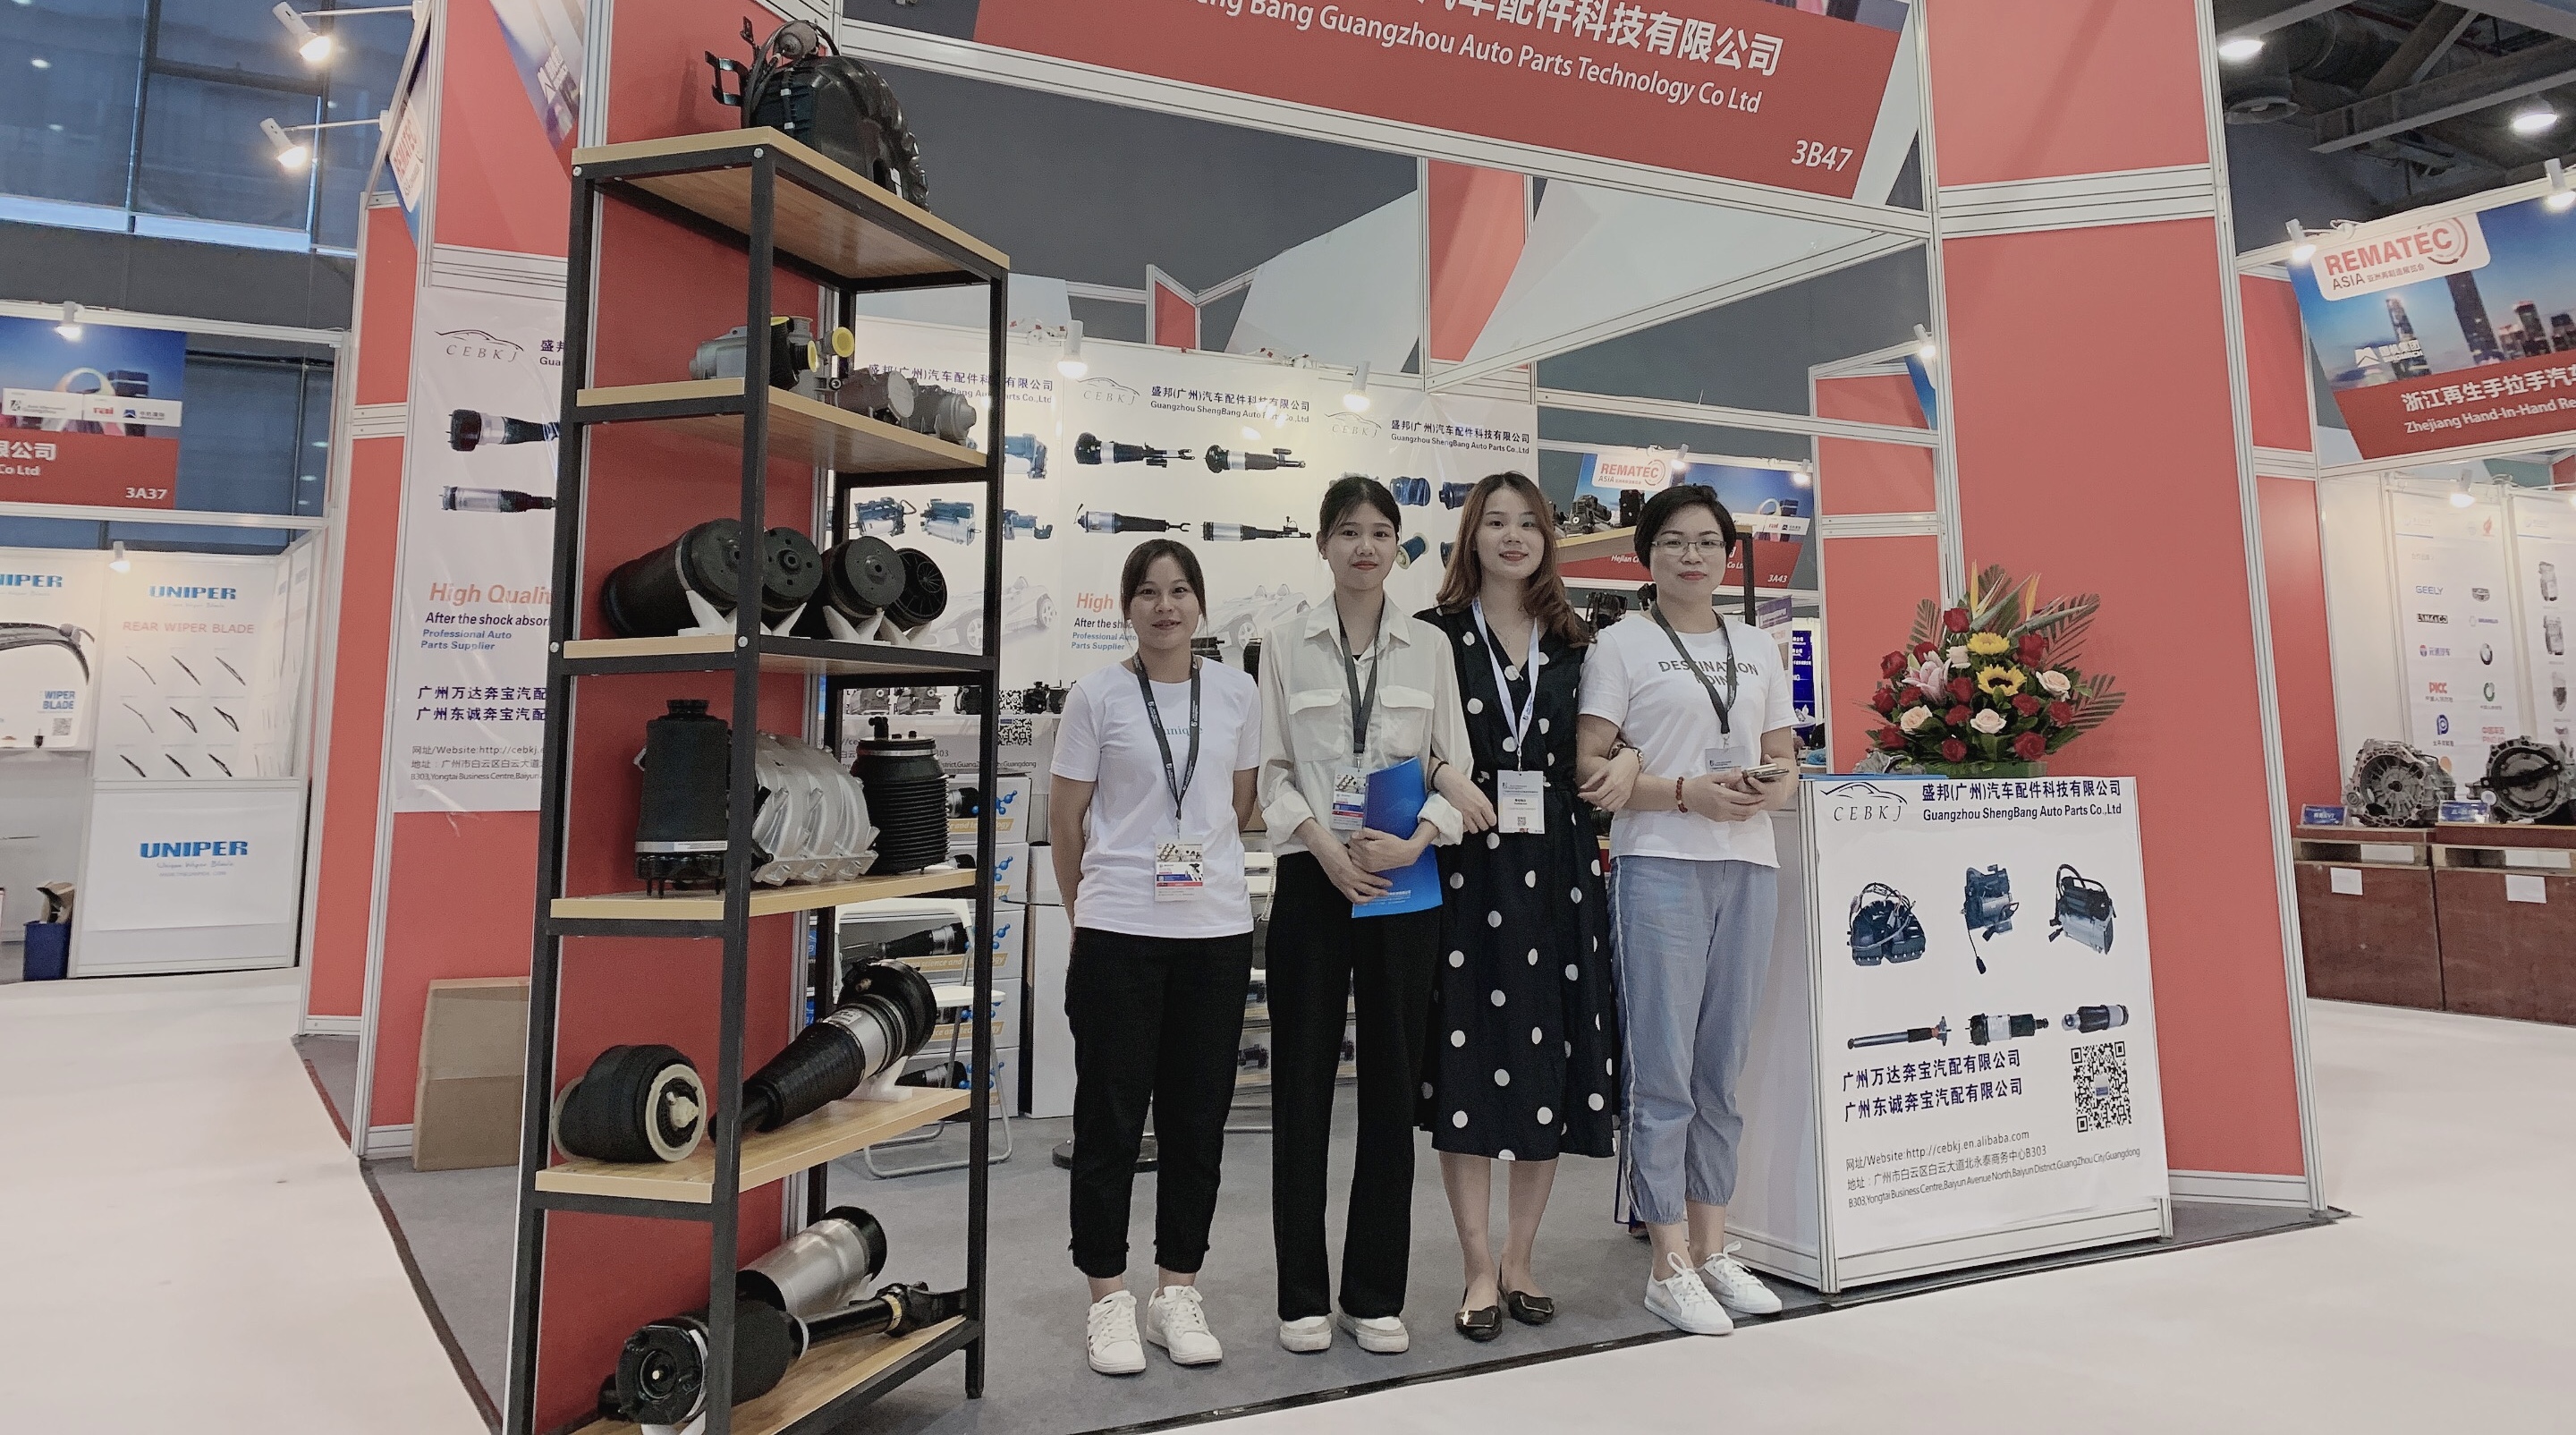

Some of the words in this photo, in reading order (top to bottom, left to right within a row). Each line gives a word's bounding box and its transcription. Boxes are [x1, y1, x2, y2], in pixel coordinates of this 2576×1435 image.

[1418, 0, 1784, 77] 配件科技有限公司
[1250, 0, 1314, 31] Bang
[1318, 4, 1455, 54] Guangzhou
[1458, 33, 1513, 65] Auto
[1517, 45, 1573, 78] Parts
[1577, 55, 1696, 106] Technology
[1699, 81, 1726, 106] Co
[1727, 90, 1763, 115] Ltd
[1791, 138, 1854, 173] 3B47
[2323, 226, 2453, 276] REMATEC
[2332, 273, 2366, 291] ASIA
[445, 344, 518, 362] CEBKJ
[869, 363, 1053, 392] 盛邦(广州)汽车配件科有限公司
[1150, 400, 1196, 412] Guangzhou
[1197, 405, 1241, 418] ShengBang
[1242, 410, 1261, 419] Auto
[2403, 416, 2462, 434] Zhejiang
[2462, 399, 2557, 425] Hand-In-Hand
[1391, 433, 1430, 444] Guangzhou
[1431, 437, 1470, 450] ShengBang
[1471, 442, 1487, 450] Auto
[1488, 443, 1505, 452] Parts
[17, 464, 41, 477] Ltd
[1597, 475, 1614, 483] ASIA
[1600, 463, 1659, 479] REMATEC
[125, 486, 168, 500] 3A37
[1767, 574, 1788, 583] 3A43
[148, 584, 237, 600] UNIPER
[428, 582, 481, 607] High
[487, 583, 553, 605] Qualit
[2415, 585, 2444, 596] GEELY
[1076, 592, 1114, 613] High
[425, 611, 456, 624] After
[457, 612, 478, 624] the
[479, 614, 513, 626] shock
[1073, 616, 1096, 628] After
[1097, 617, 1112, 628] the
[122, 621, 159, 633] REAR
[164, 621, 208, 634] WIPER
[211, 623, 255, 634] BLADE
[421, 629, 486, 639] Professional
[487, 630, 513, 640] Auto
[1072, 632, 1118, 641] Professional
[419, 641, 448, 650] Parts
[450, 641, 496, 651] Supplier
[1071, 641, 1090, 650] Parts
[1092, 642, 1125, 651] Supplier
[44, 690, 76, 701] WIPER
[42, 700, 75, 710] BLADE
[459, 772, 489, 780] Business
[1833, 805, 1902, 822] CEBKJ
[1923, 807, 1980, 823] Guangzhou
[1982, 806, 2038, 820] ShengBang
[2039, 804, 2063, 818] Auto
[2064, 804, 2089, 816] Parts
[140, 841, 249, 859] UNIPER
[1843, 1049, 2021, 1092] 广州万达奔宝汽配有限公司
[1843, 1077, 2023, 1123] 广州东诚奔宝汽配有限公司
[1891, 1185, 1920, 1199] Business
[1966, 1174, 1992, 1185] Avenue
